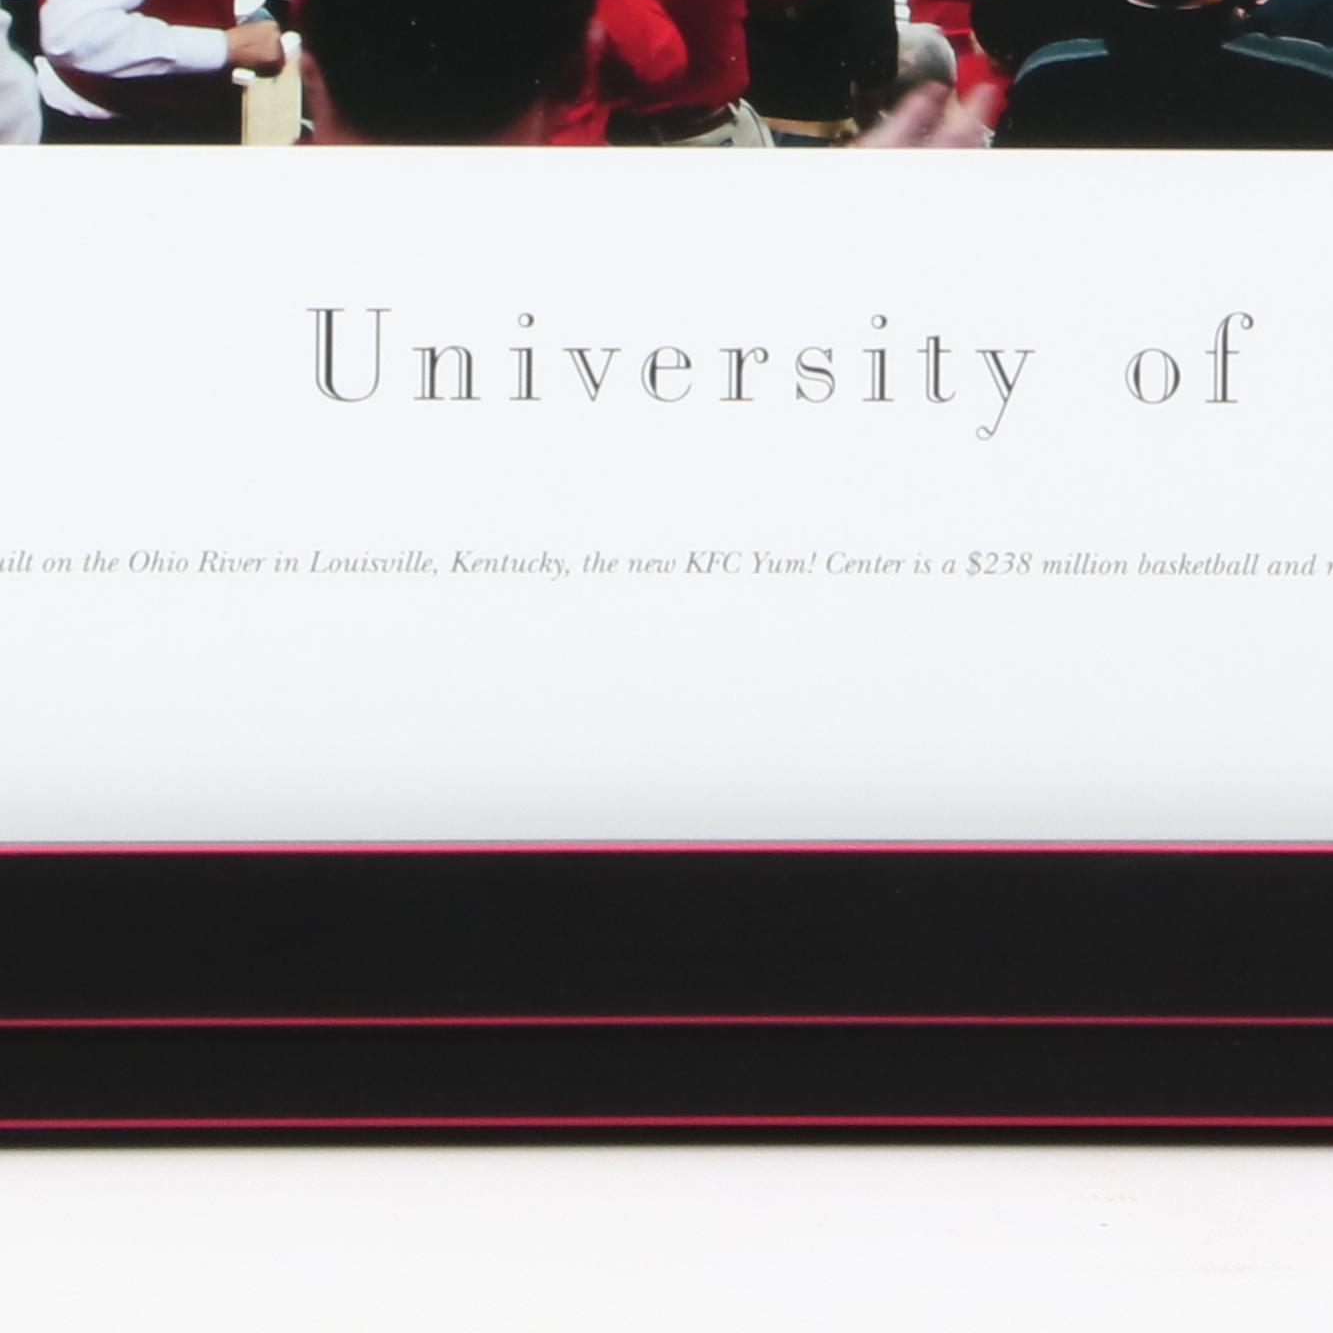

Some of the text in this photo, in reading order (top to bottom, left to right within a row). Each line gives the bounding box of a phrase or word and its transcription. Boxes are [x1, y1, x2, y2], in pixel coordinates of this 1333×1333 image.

[305, 309, 1034, 436] University
[1126, 313, 1253, 403] of
[42, 558, 71, 572] on
[83, 550, 119, 572] the
[129, 550, 188, 572] Ohio
[198, 550, 266, 572] River
[275, 551, 298, 572] in
[310, 551, 437, 575] Louisville,
[451, 551, 570, 581] Kentucky,
[583, 551, 618, 573] the
[629, 559, 676, 573] new
[685, 551, 742, 573] KFC
[754, 551, 816, 573] Yum!
[826, 552, 905, 573] Center
[914, 552, 931, 574] is
[942, 560, 956, 574] a
[966, 551, 1032, 576] $238
[1043, 553, 1127, 575] million
[1138, 553, 1259, 575] basketball
[1267, 554, 1317, 576] and
